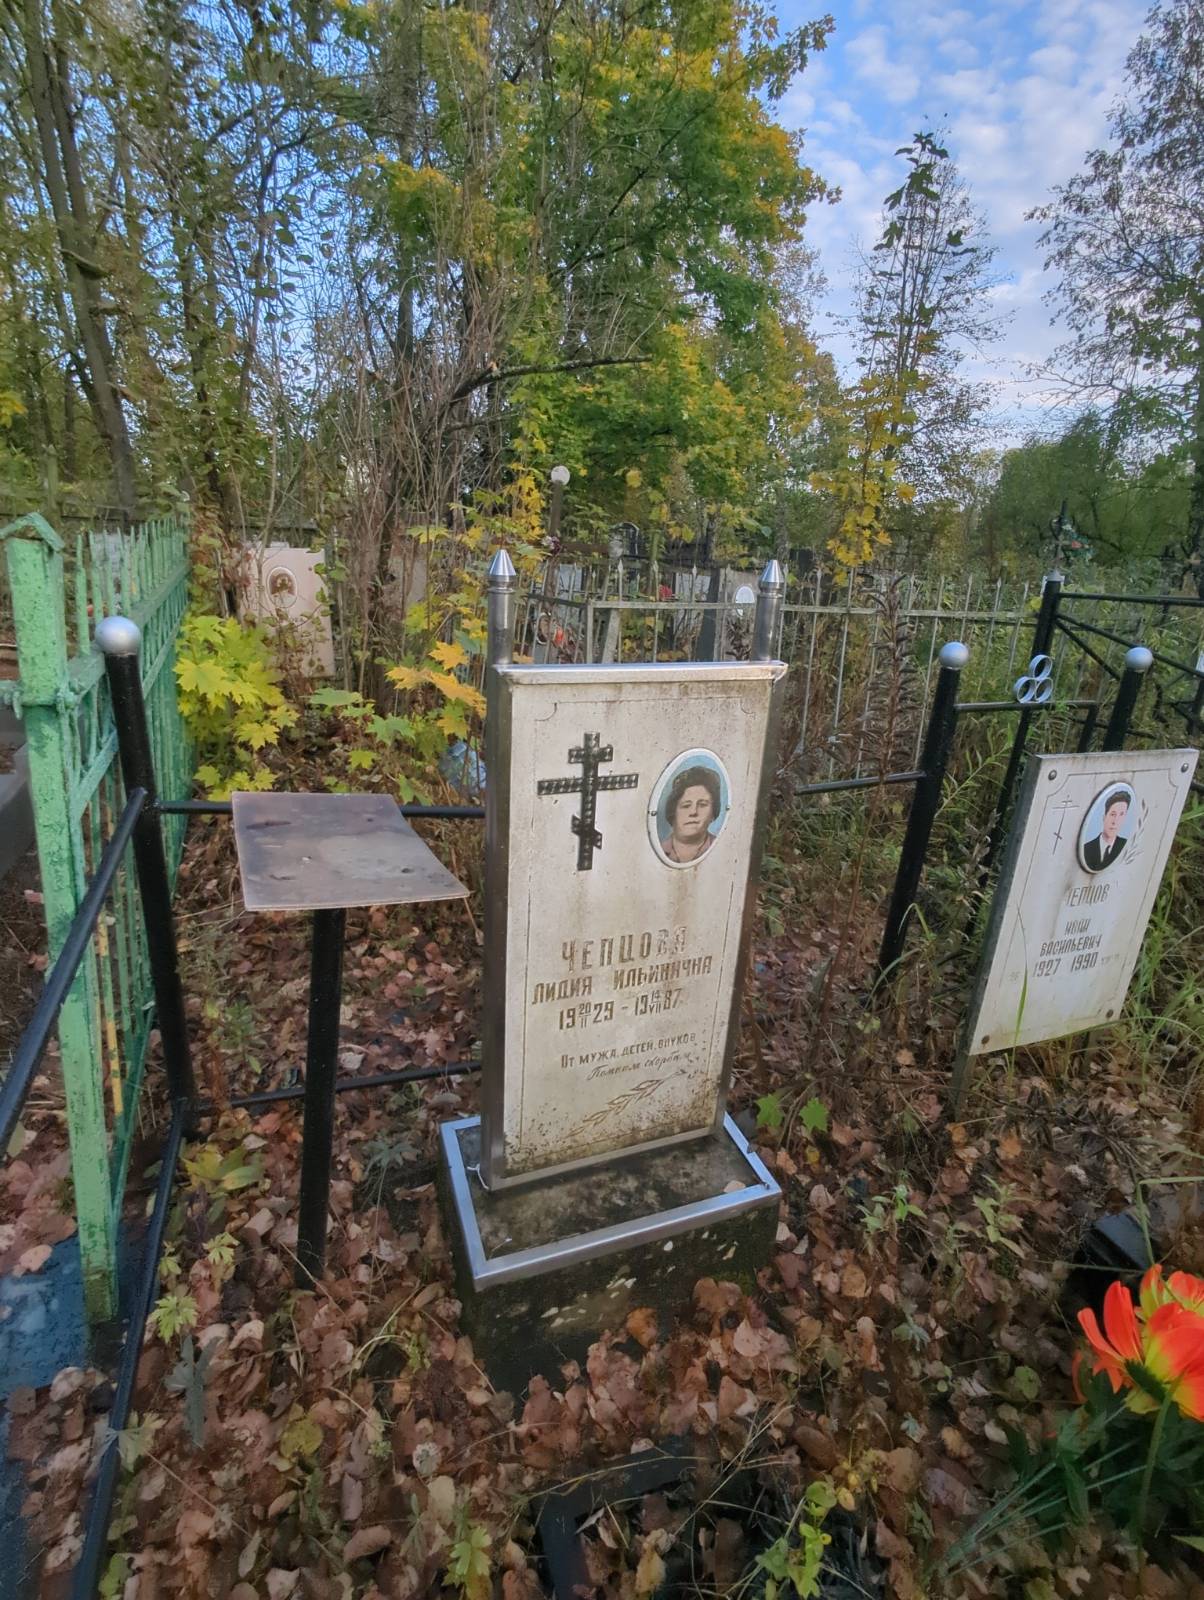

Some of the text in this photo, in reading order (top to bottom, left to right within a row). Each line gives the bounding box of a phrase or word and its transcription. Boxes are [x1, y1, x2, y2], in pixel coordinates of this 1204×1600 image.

[562, 926, 687, 973] ЧЕПЦОВА
[1040, 935, 1103, 957] ВАСИЛЬЕВИЧ
[1033, 958, 1061, 978] 1927
[1070, 951, 1099, 973] 1990
[531, 955, 713, 1005] ЛИДИЯ ИЛЬИНИЧНА
[658, 1032, 696, 1049] ВНУКОВ
